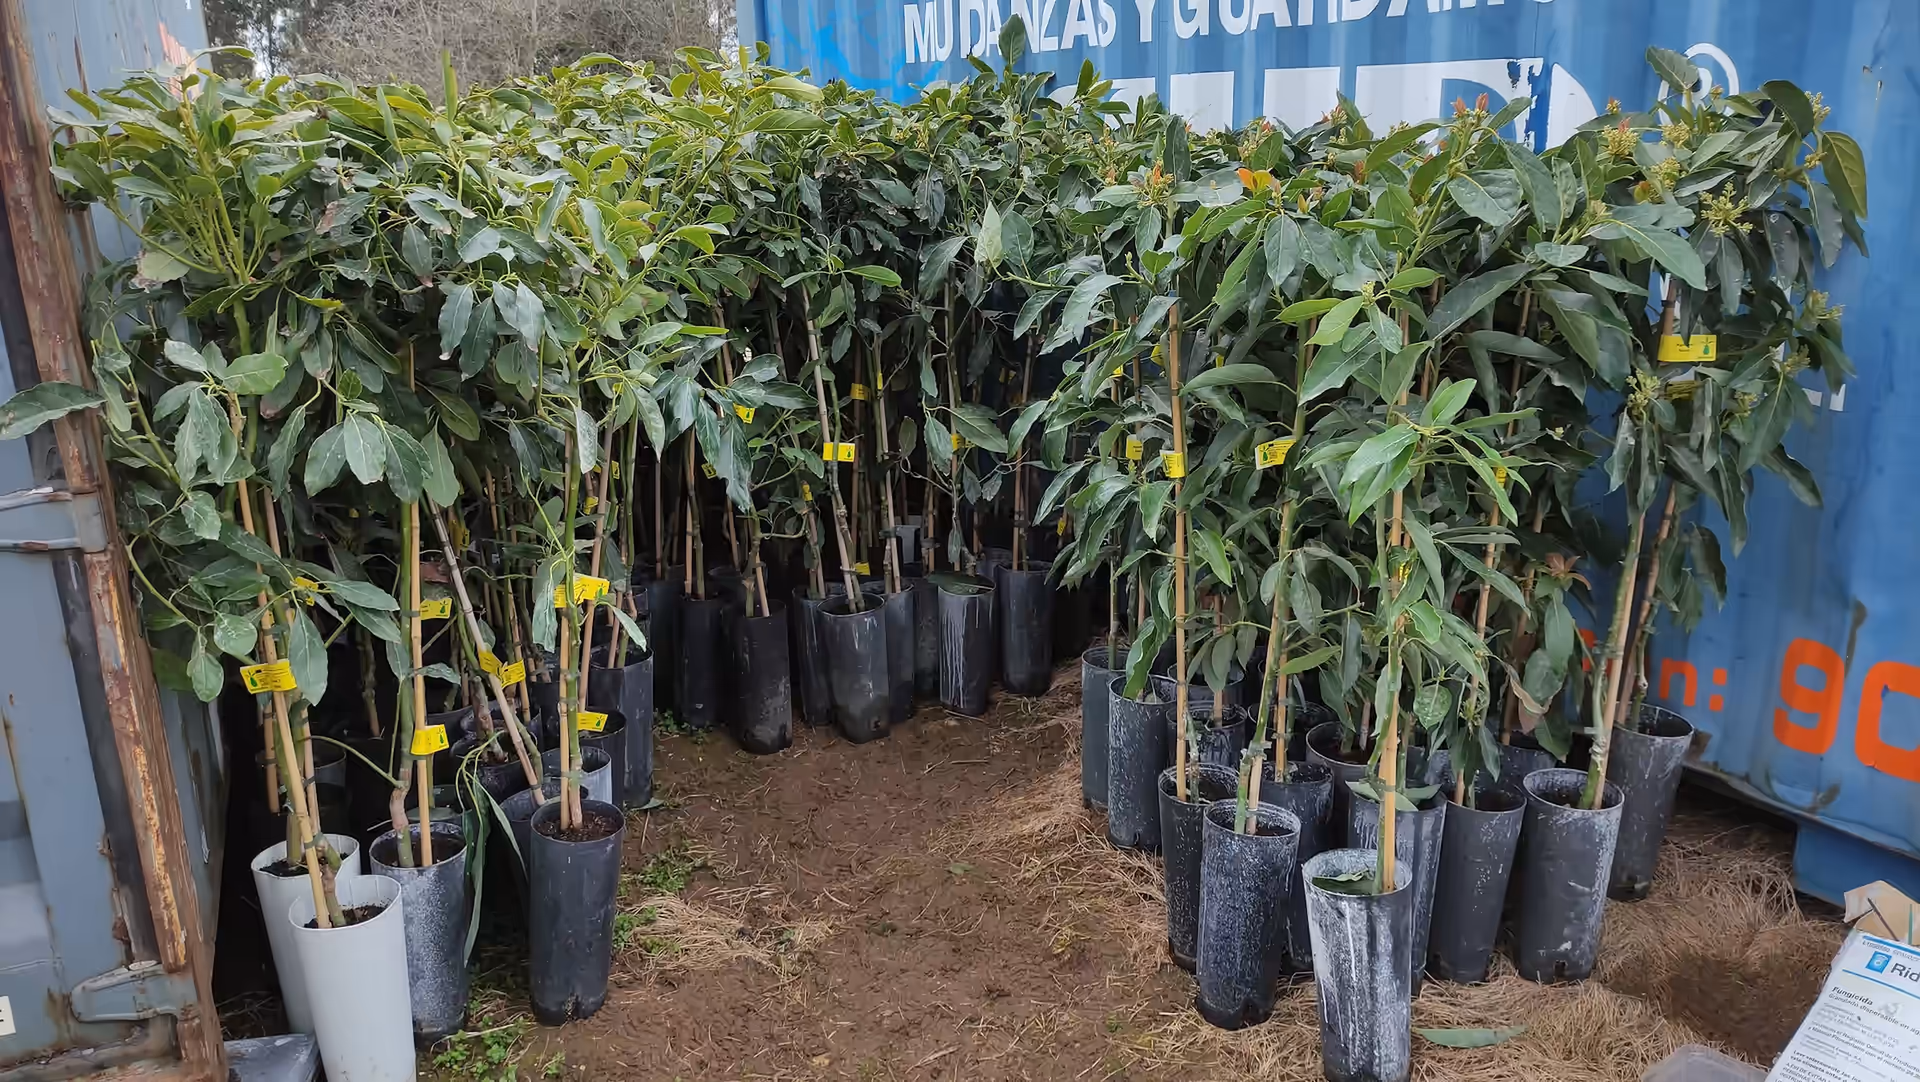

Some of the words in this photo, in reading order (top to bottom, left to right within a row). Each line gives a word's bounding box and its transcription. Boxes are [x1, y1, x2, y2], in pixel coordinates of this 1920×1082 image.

[904, 0, 1116, 64] MUDANZAS
[1134, 0, 1155, 42] Y
[1831, 986, 1873, 1006] Fungicida
